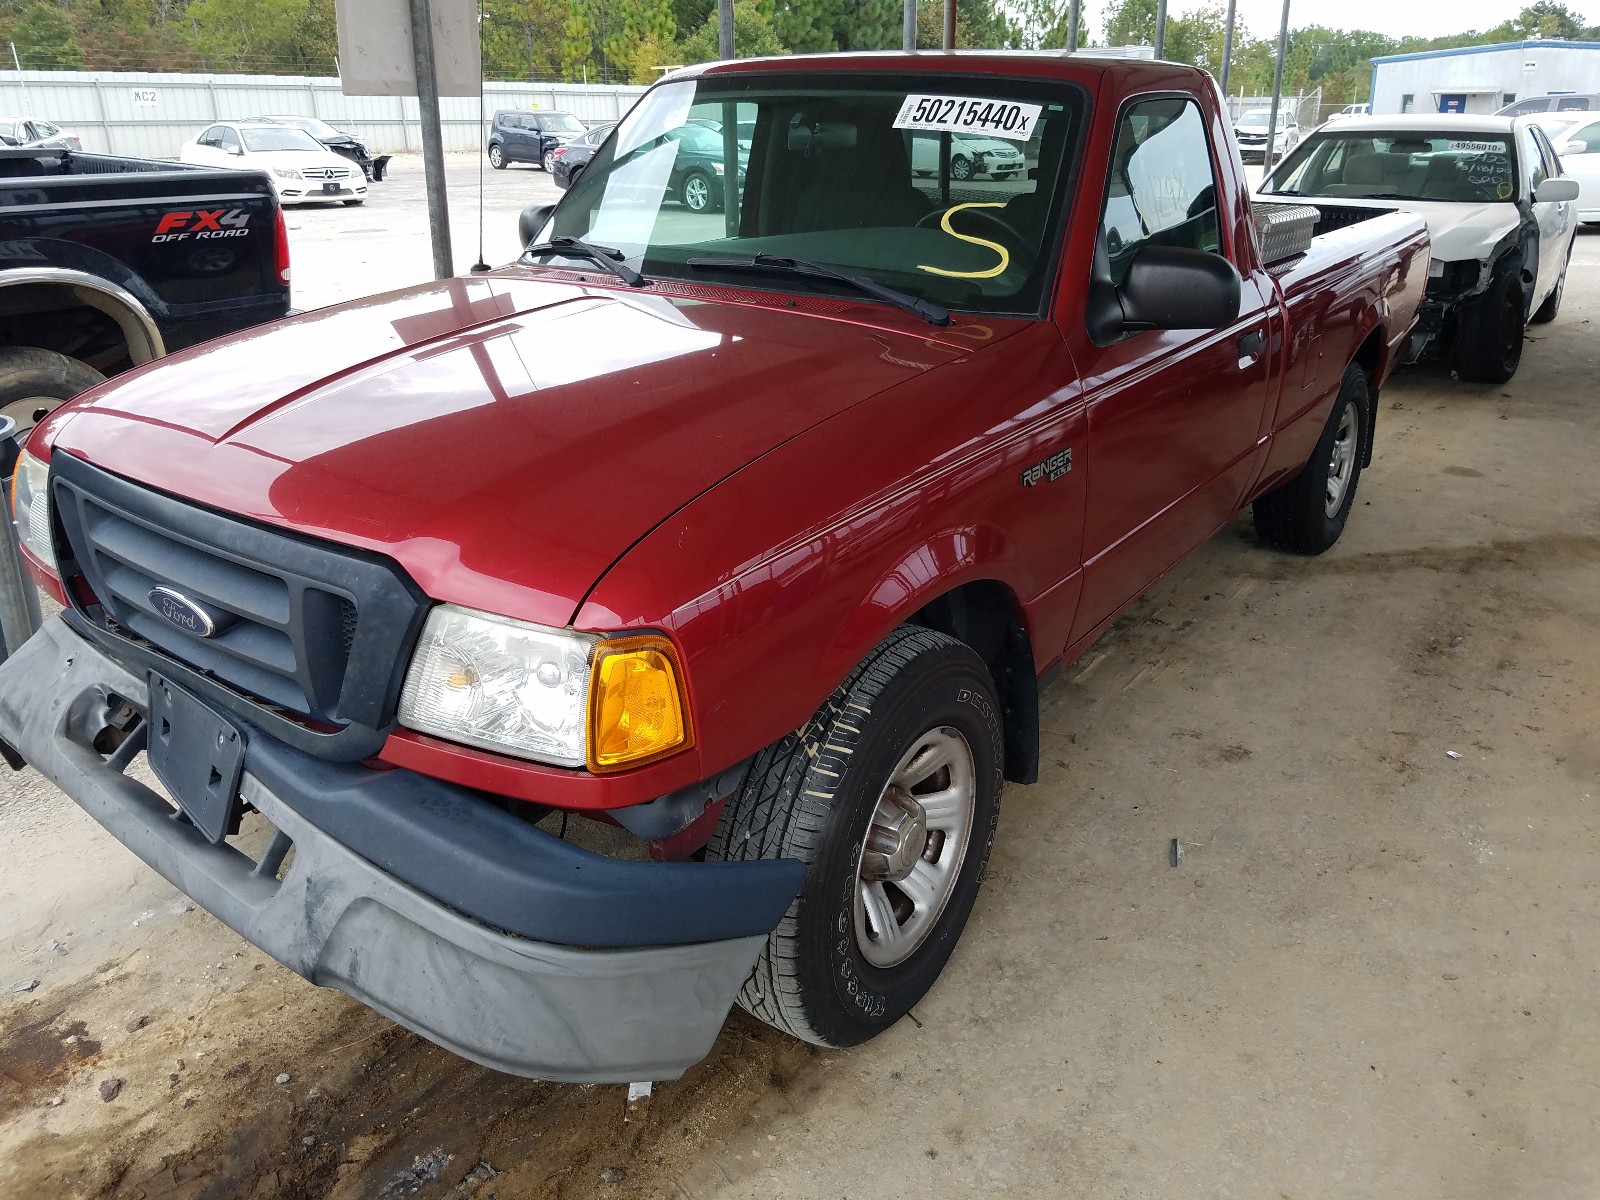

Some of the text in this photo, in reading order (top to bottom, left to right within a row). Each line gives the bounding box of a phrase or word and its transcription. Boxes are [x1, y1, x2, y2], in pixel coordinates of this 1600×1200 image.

[134, 91, 157, 102] MC2
[155, 208, 251, 234] FX4
[151, 228, 250, 244] OFF ROAD
[916, 202, 1010, 279] S
[1023, 447, 1073, 487] RANGER
[1050, 462, 1072, 482] XLT
[162, 597, 197, 630] Ford
